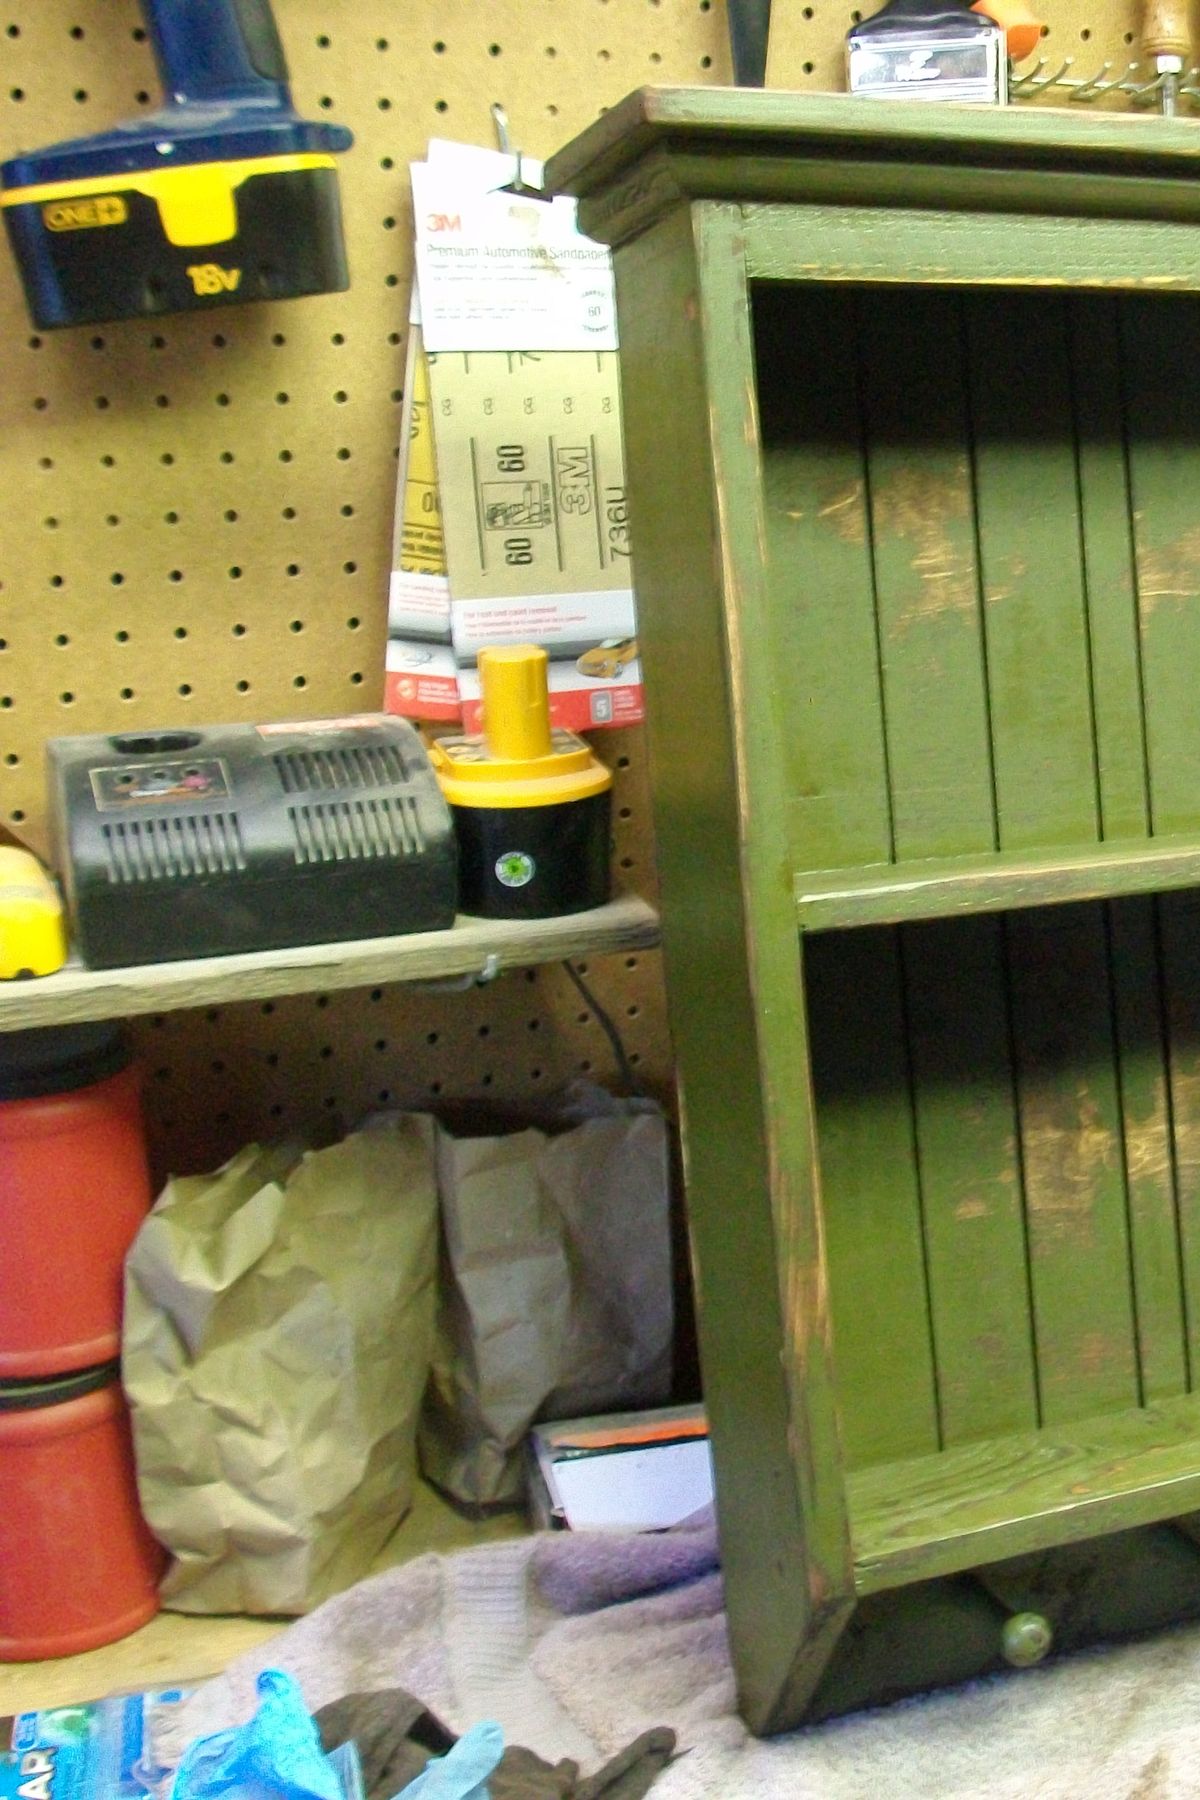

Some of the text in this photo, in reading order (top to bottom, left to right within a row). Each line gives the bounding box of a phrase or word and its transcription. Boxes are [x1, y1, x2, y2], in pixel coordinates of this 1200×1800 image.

[427, 213, 462, 232] 3M
[427, 244, 479, 258] Premium
[484, 245, 547, 260] Automotive
[496, 445, 526, 473] 60
[556, 446, 593, 516] 3M
[504, 537, 533, 566] 60
